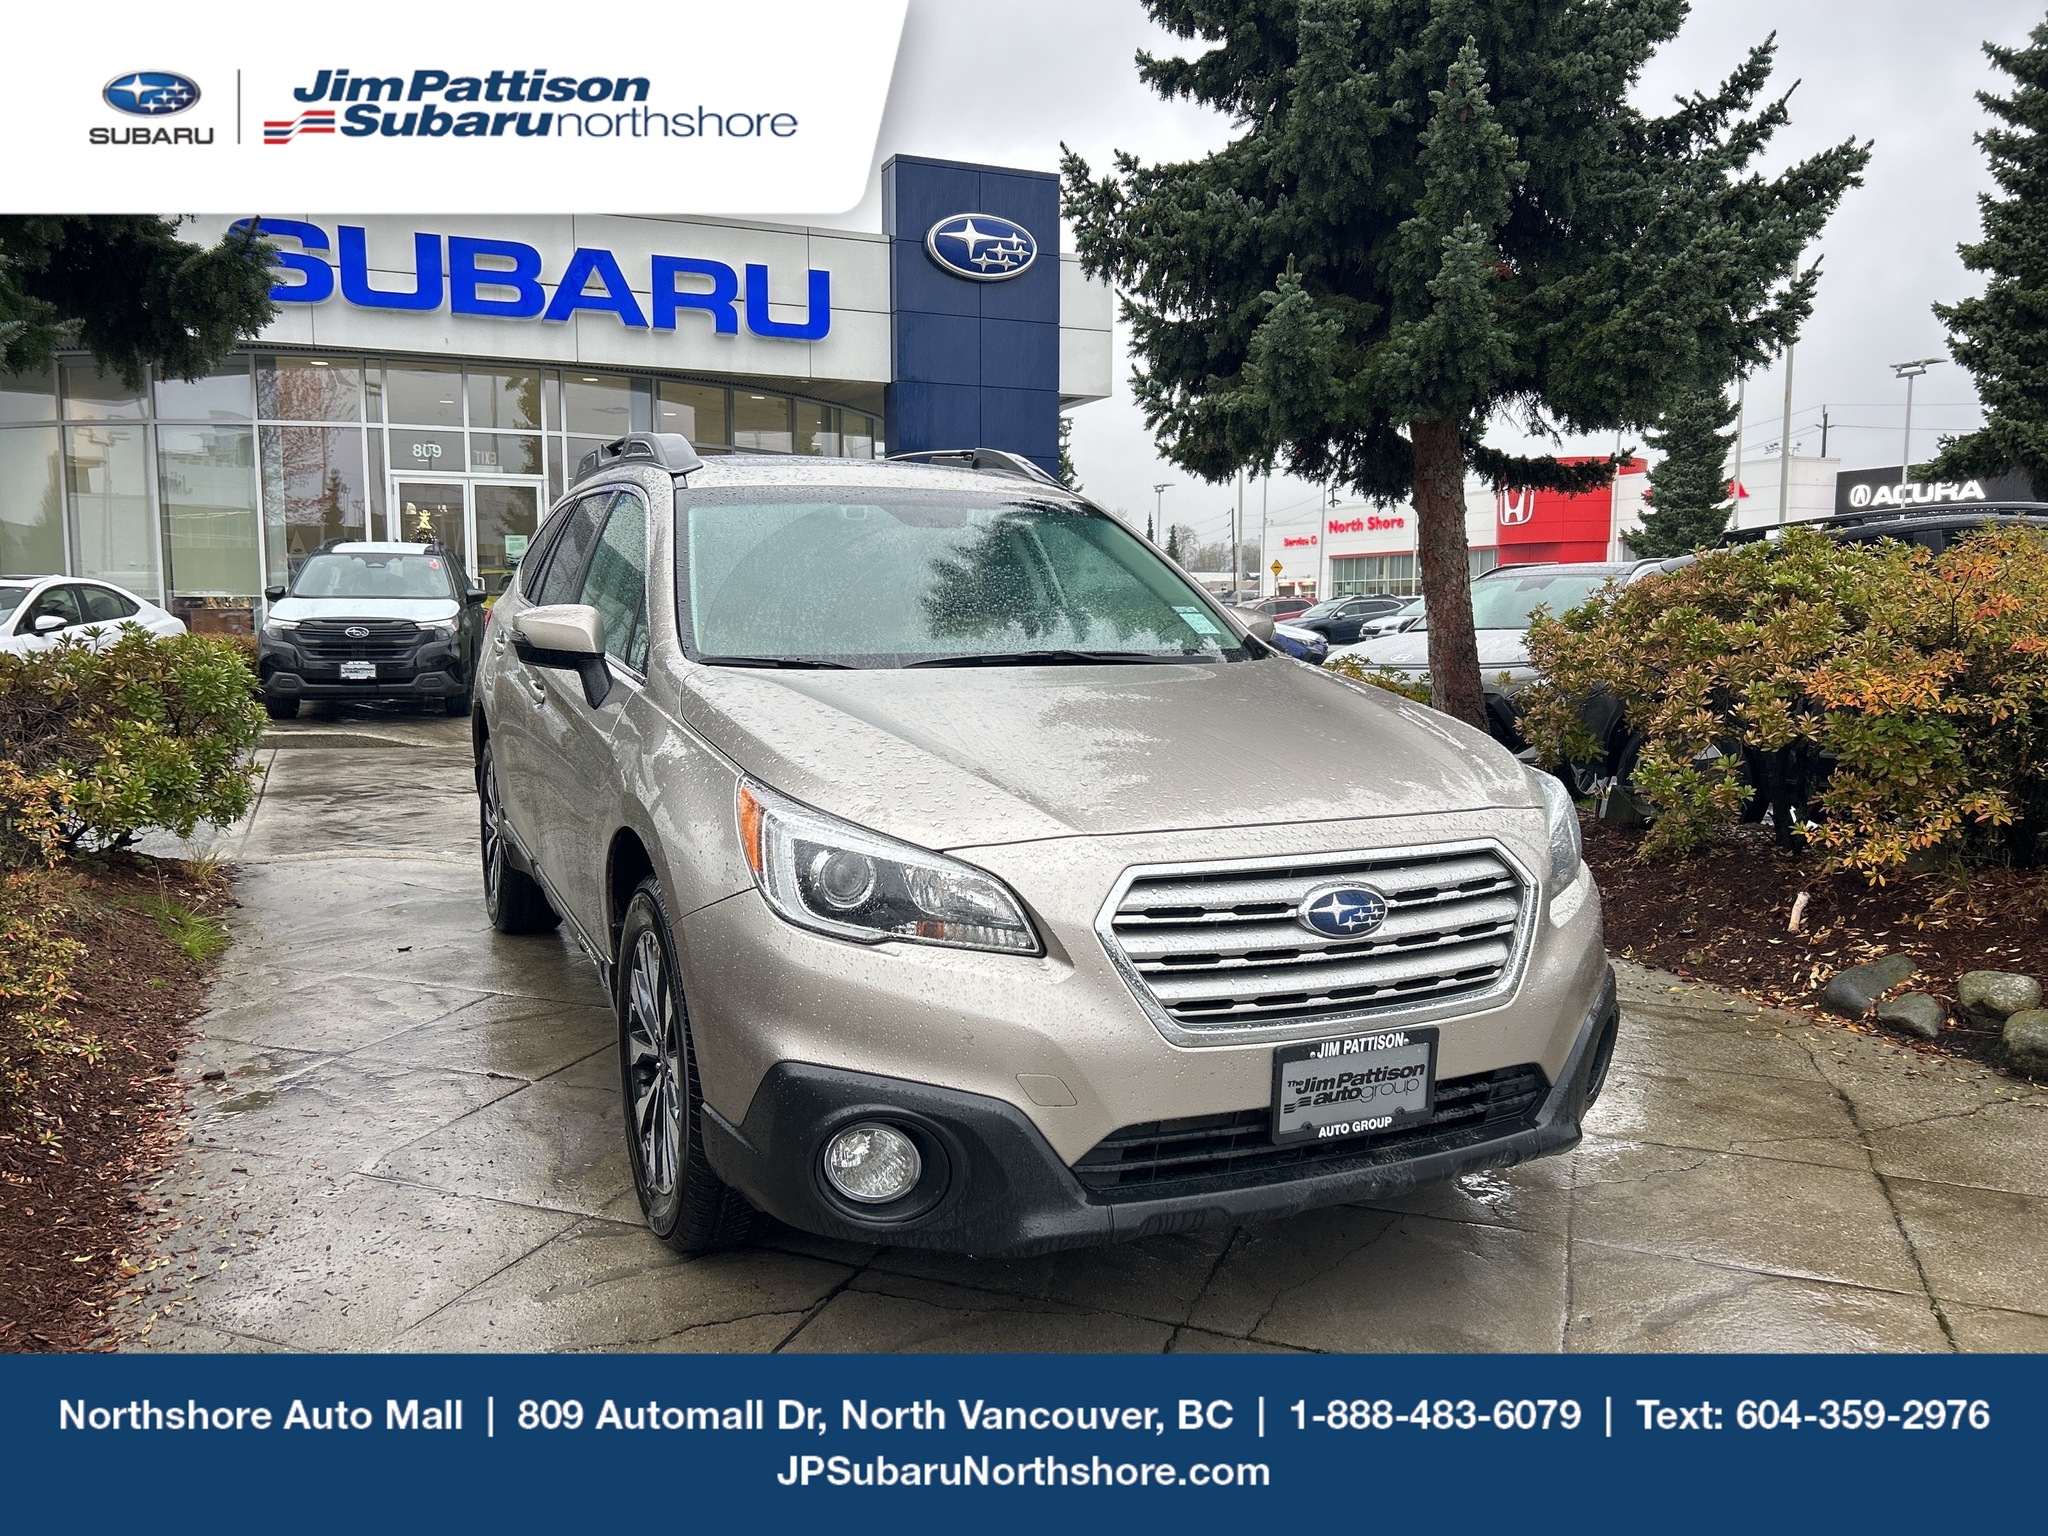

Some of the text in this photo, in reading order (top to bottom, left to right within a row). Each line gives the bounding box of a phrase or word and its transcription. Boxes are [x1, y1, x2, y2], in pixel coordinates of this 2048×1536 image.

[228, 217, 830, 341] SUBARU
[412, 443, 443, 458] 809
[1871, 478, 1986, 506] ACURA
[1329, 516, 1404, 534] North Shore
[1283, 536, 1309, 548] Service
[1317, 1032, 1405, 1059] JIM PATTISON
[1287, 1063, 1426, 1095] The Jim Pattison
[1318, 1116, 1393, 1139] AUTO GROUP
